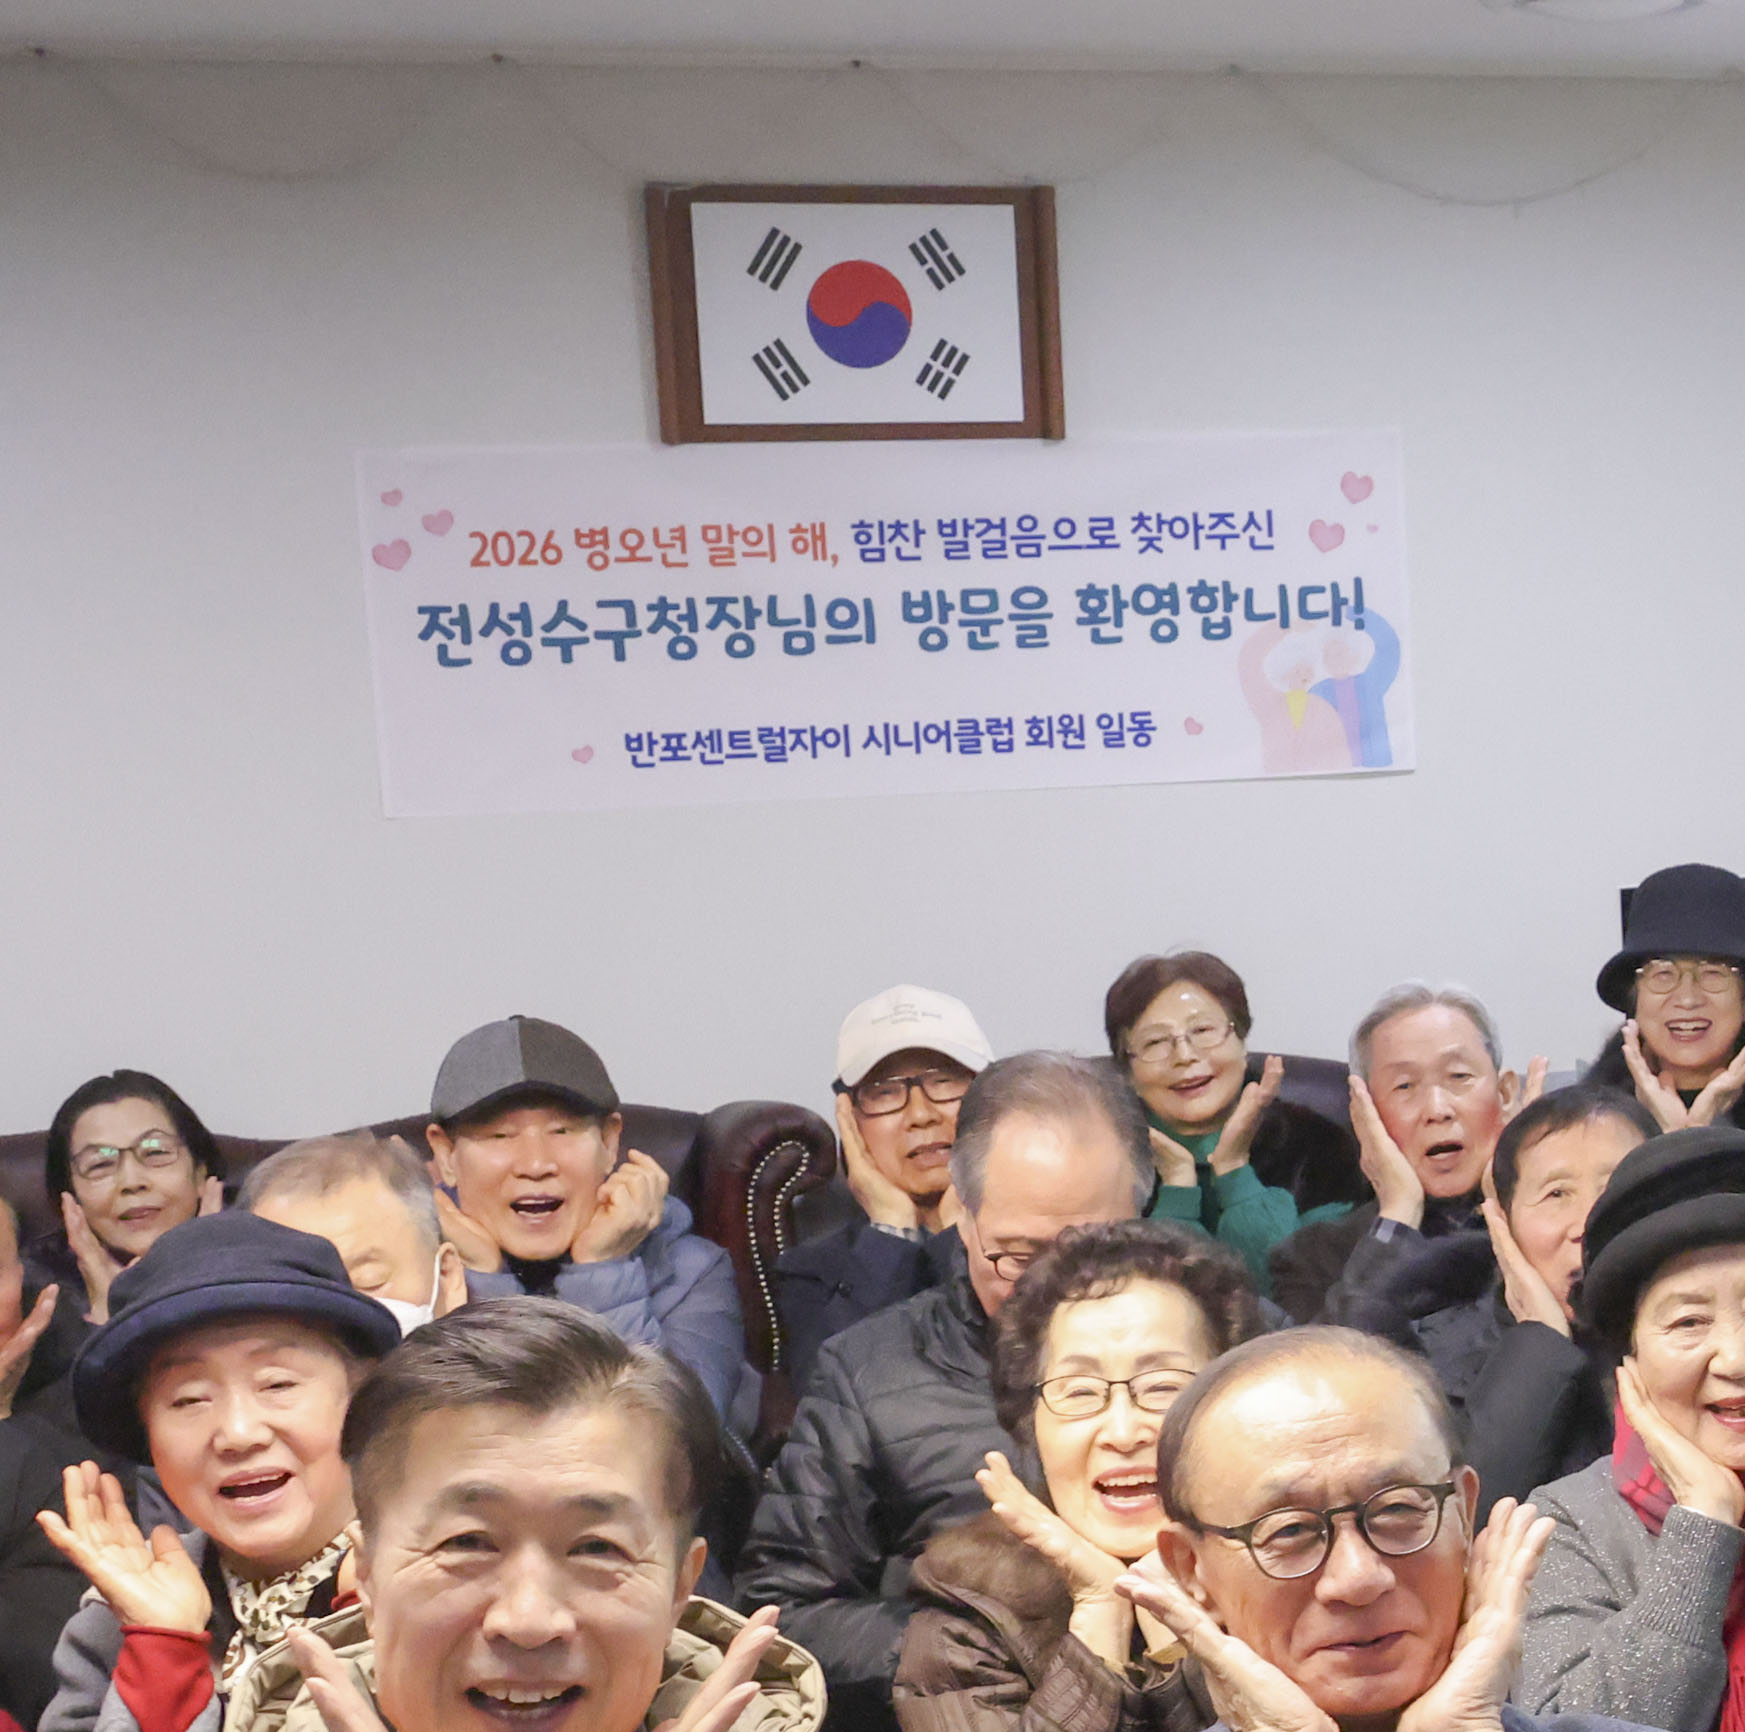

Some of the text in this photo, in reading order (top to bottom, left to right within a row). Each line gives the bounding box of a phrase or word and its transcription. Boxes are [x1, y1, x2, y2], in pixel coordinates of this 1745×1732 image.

[470, 509, 1274, 571] 2026 병오년 말의 해, 힘찬 발걸음으로 찾아주신
[418, 577, 1365, 667] 전성수구청장님의 방문을 환영합니다!
[625, 711, 1157, 768] 반포센트럴자이 시니어클럽 회원 일동
